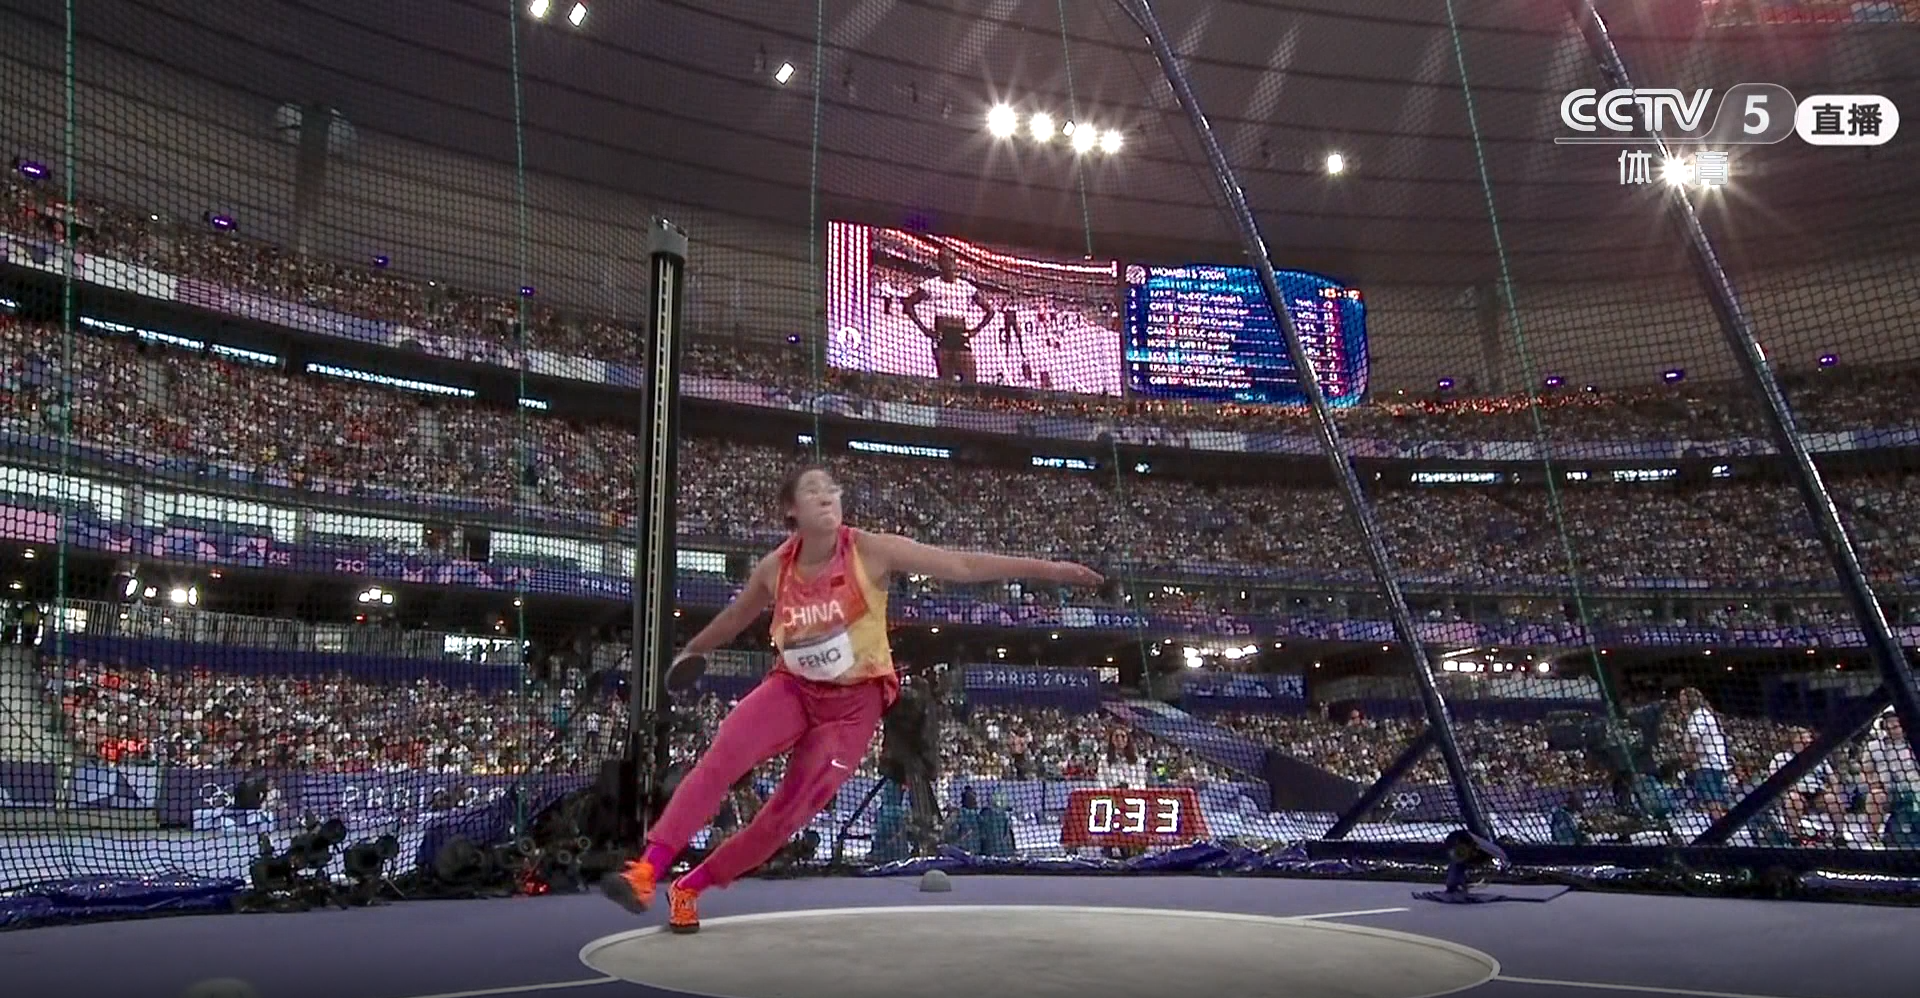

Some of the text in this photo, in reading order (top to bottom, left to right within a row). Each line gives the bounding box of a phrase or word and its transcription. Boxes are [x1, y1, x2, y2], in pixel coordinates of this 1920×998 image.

[782, 599, 845, 627] CHINA
[984, 671, 1089, 688] PARIS 2024
[1089, 797, 1180, 833] 0:33
